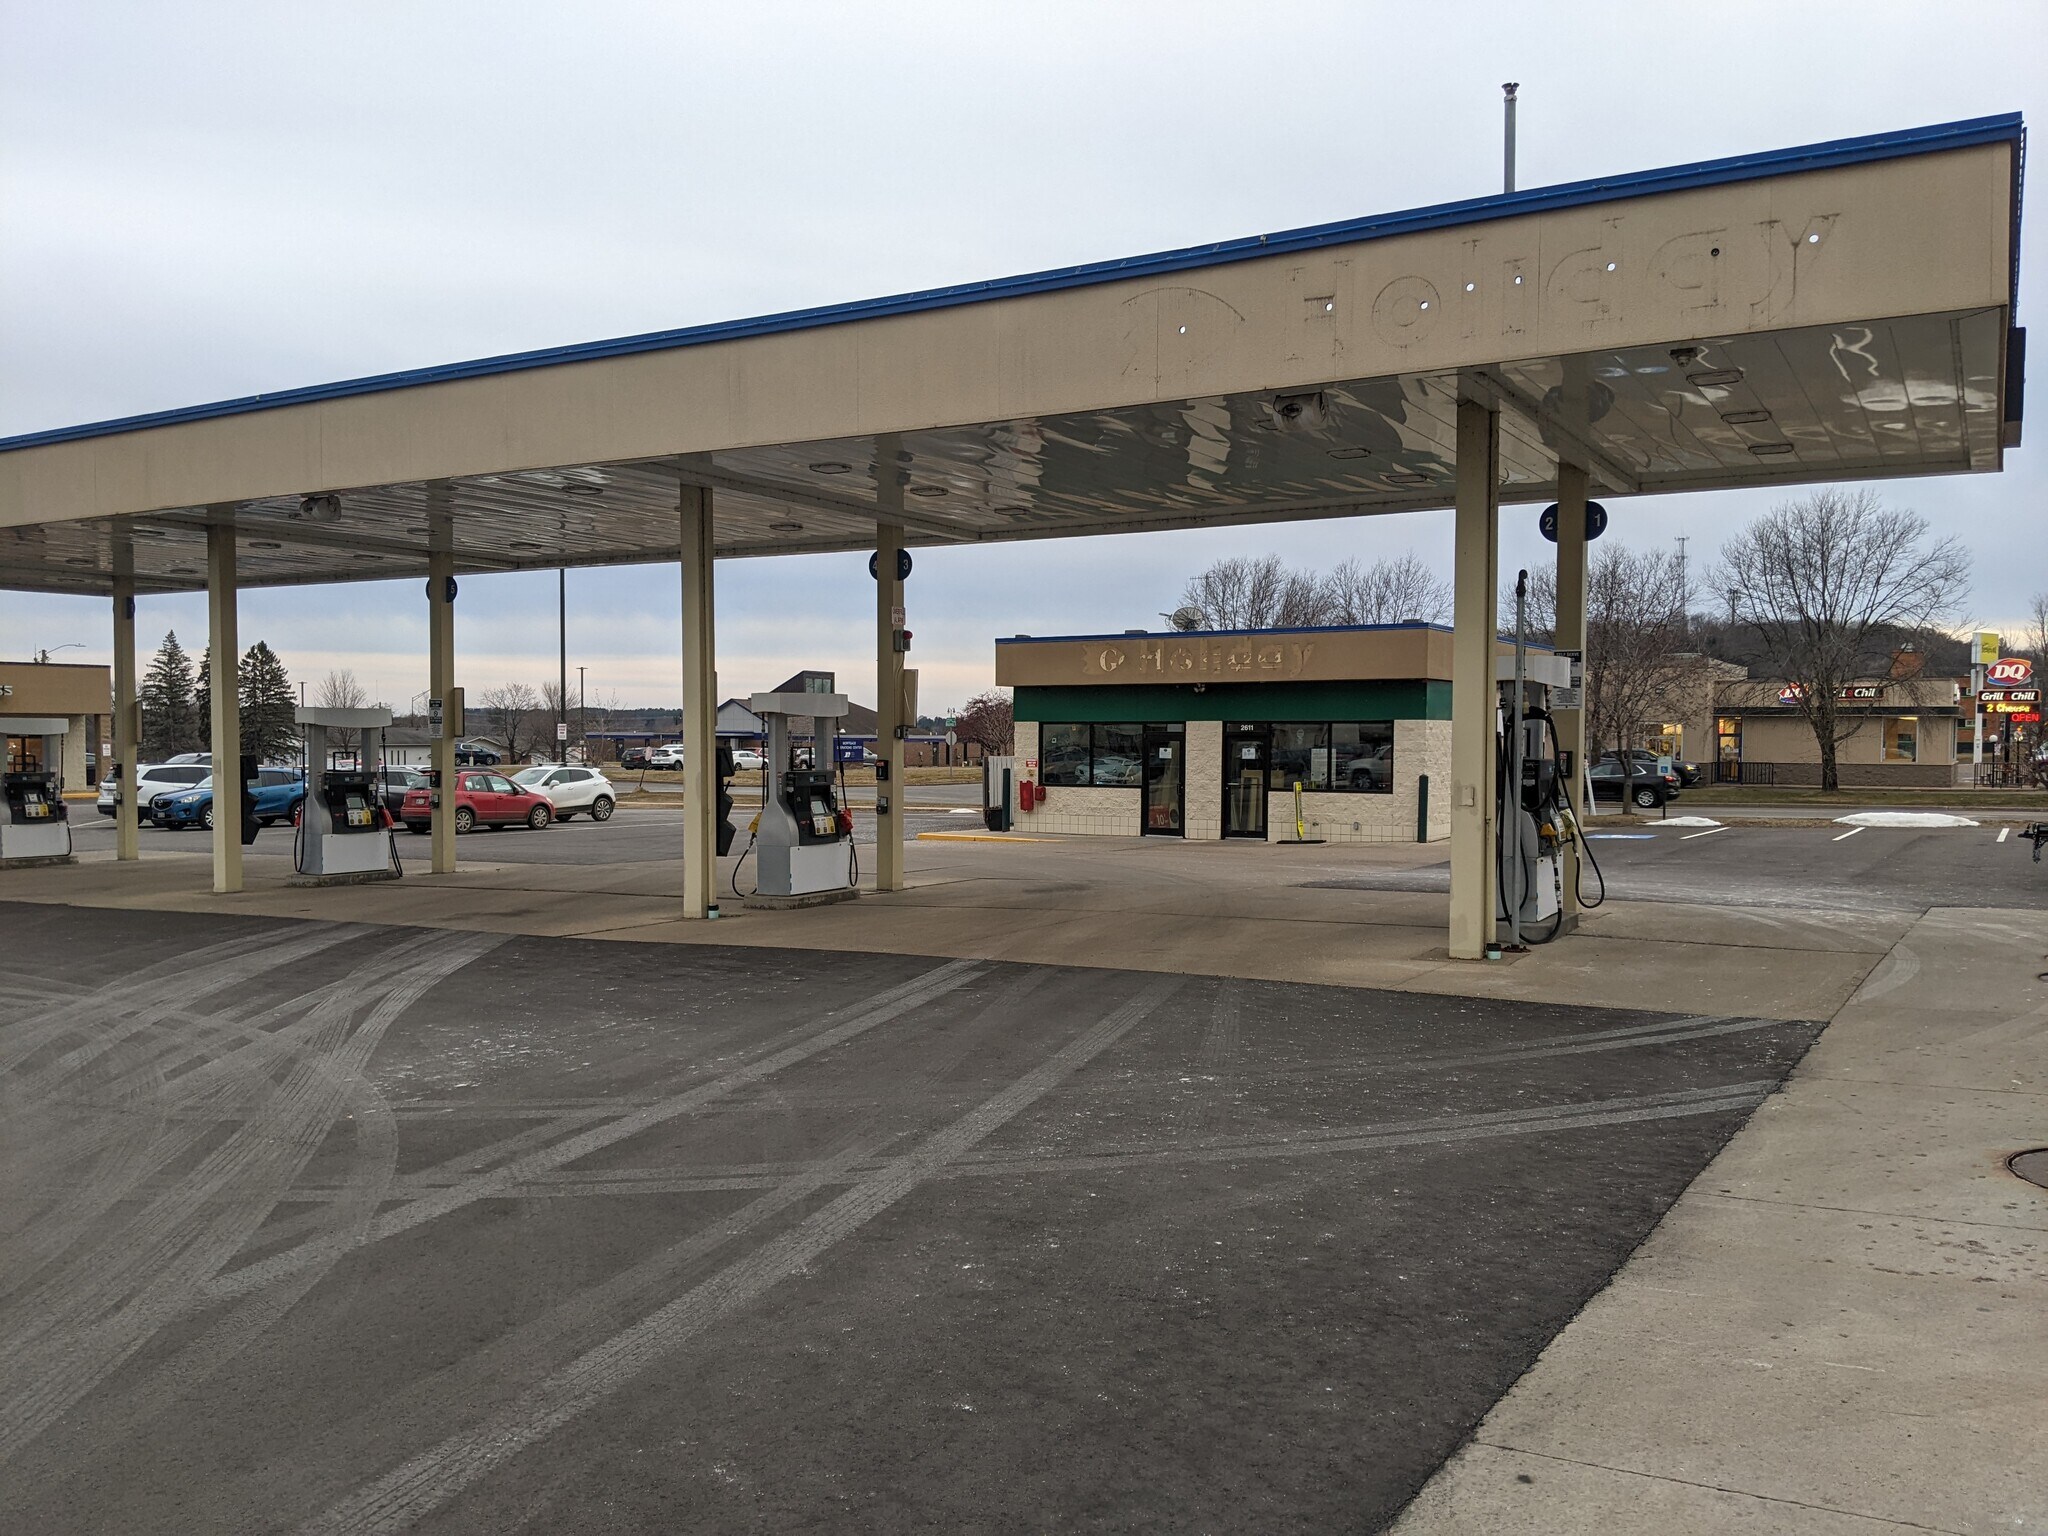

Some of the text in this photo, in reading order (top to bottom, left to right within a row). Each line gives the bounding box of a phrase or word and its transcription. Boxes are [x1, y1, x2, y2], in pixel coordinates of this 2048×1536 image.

[1545, 516, 1554, 531] 2
[1594, 513, 1601, 528] 1
[903, 559, 909, 570] 3
[1993, 664, 2026, 680] DQ
[1981, 692, 2005, 701] Grill
[2011, 692, 2036, 701] Chill
[1986, 703, 1994, 712] 2
[2011, 713, 2039, 722] OPEN
